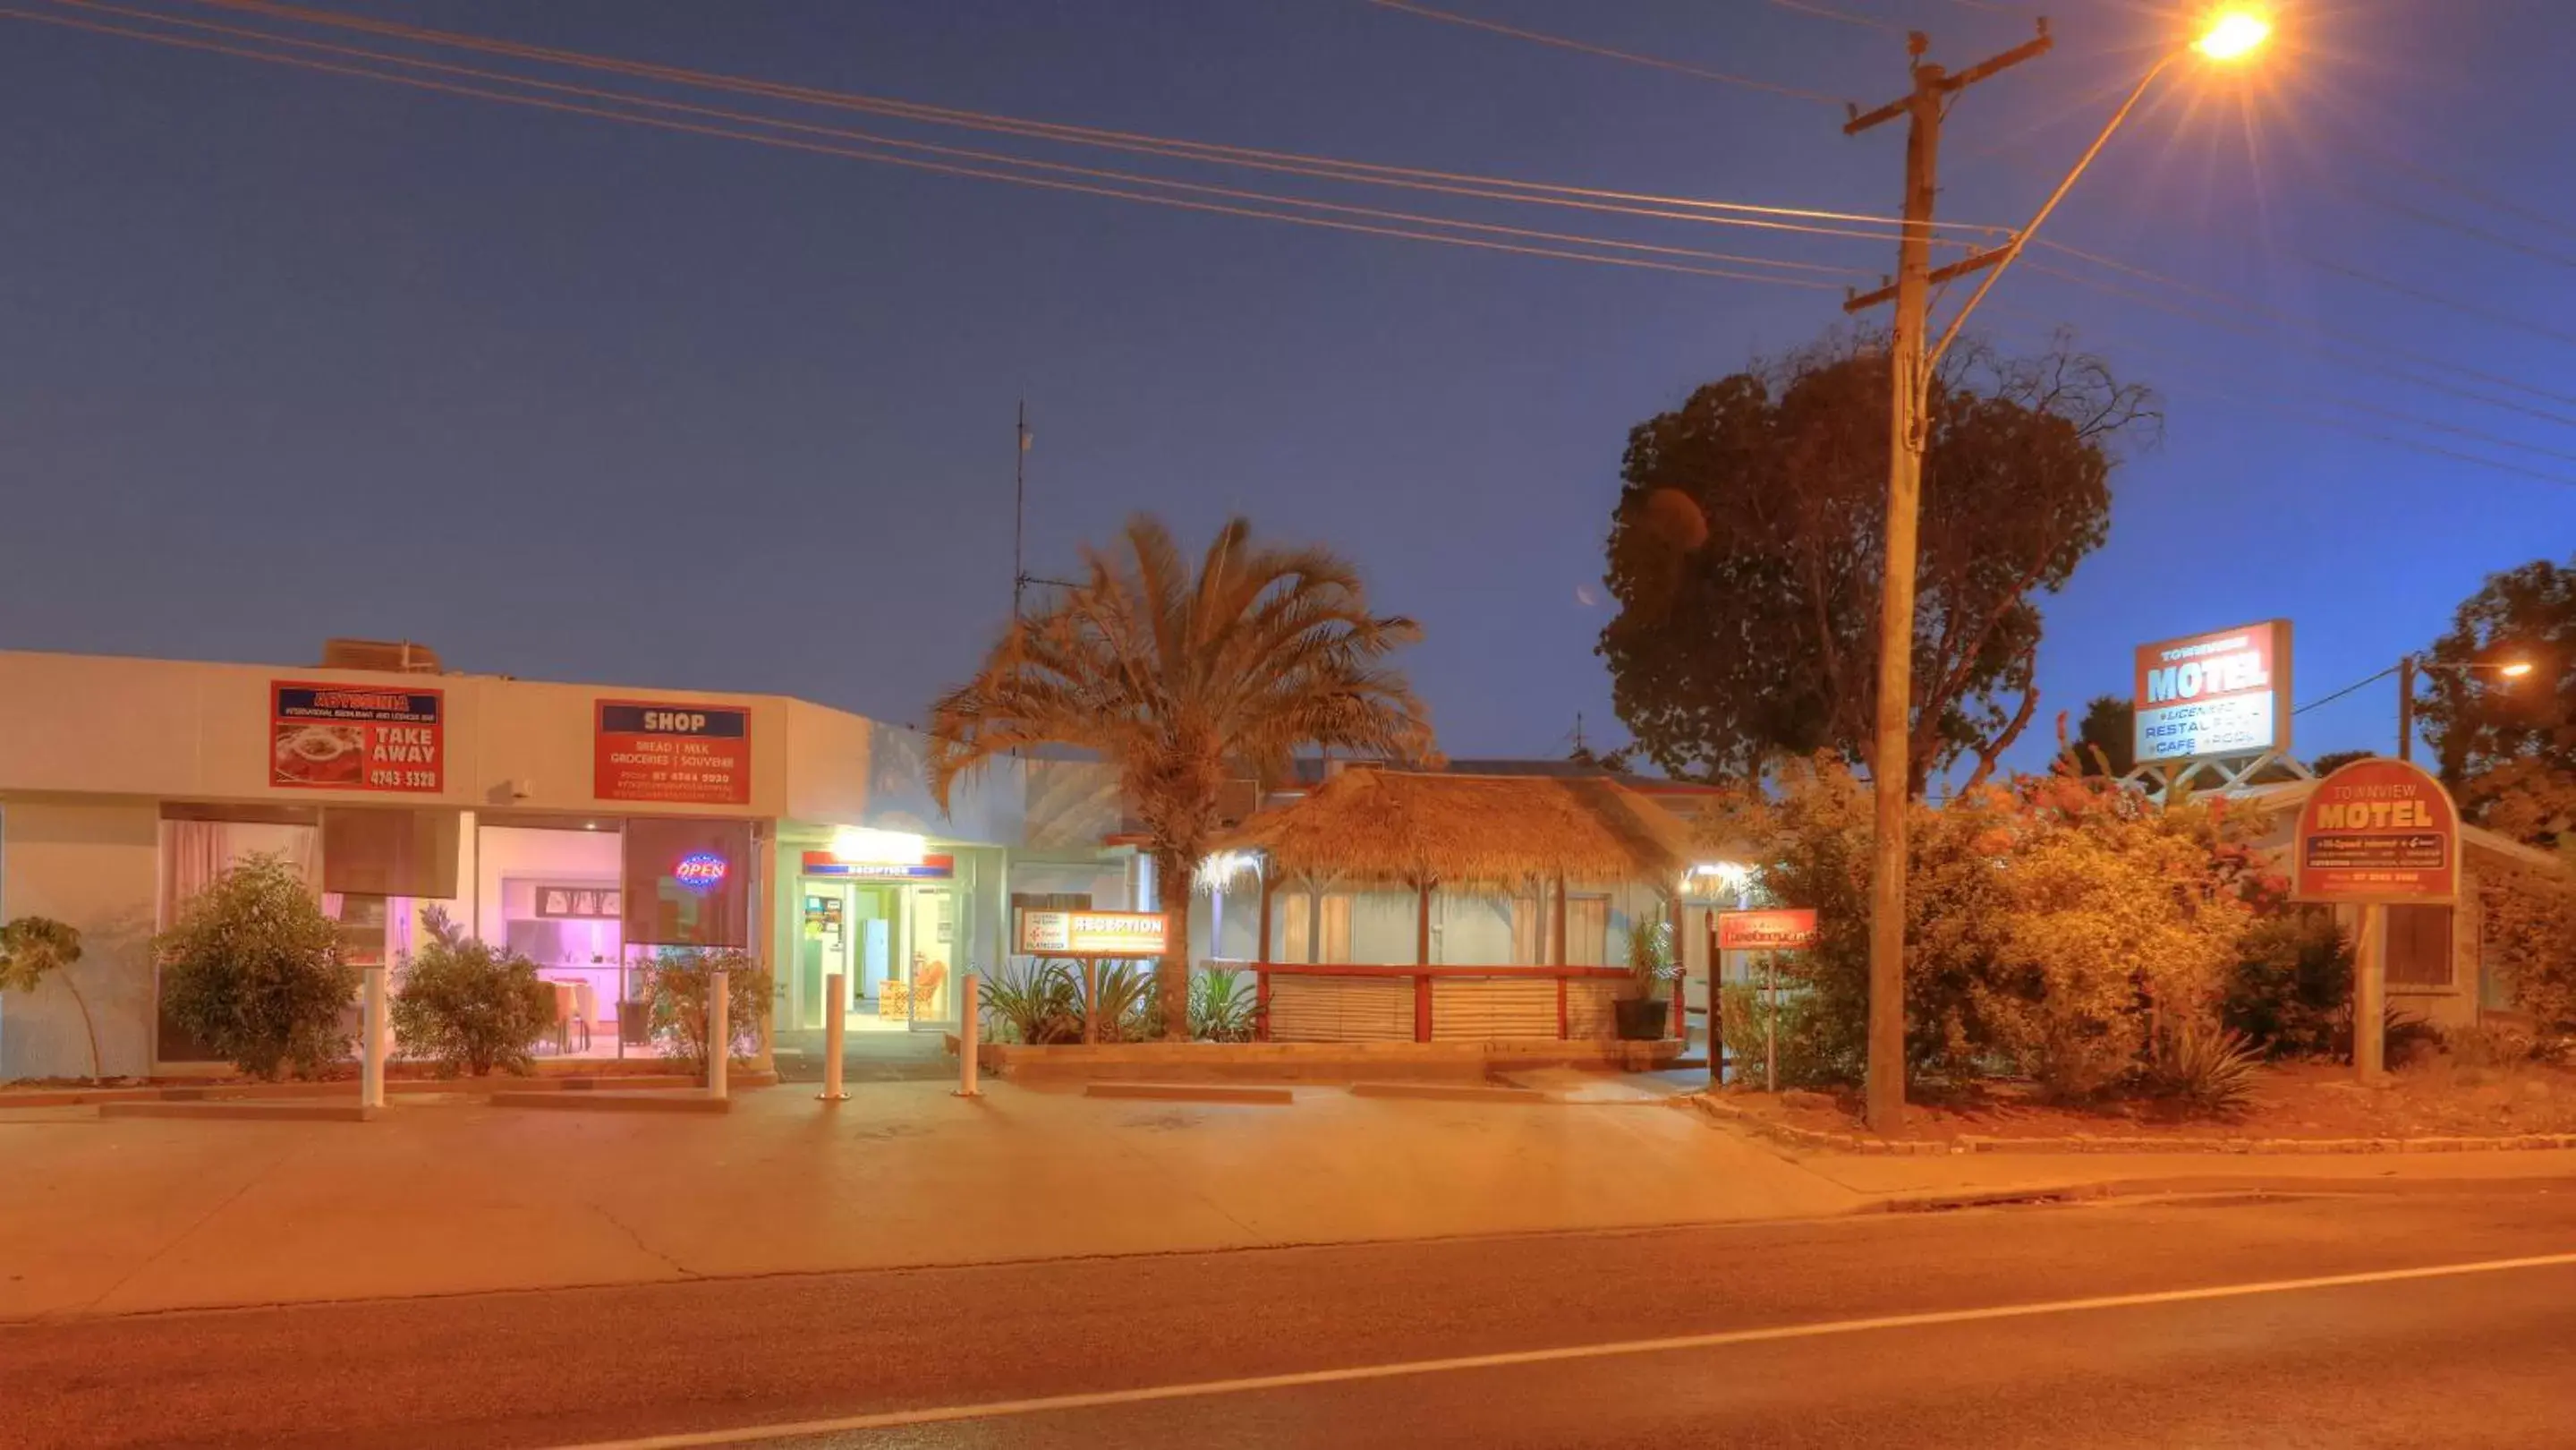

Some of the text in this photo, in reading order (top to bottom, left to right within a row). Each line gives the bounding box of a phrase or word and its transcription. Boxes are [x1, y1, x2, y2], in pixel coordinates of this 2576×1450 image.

[2161, 636, 2249, 661] TOWN
[2148, 651, 2268, 704] MOTEL
[644, 712, 705, 731] SHOP
[2146, 712, 2260, 738] RESTAU
[376, 727, 433, 745] TAKE
[373, 745, 435, 763] AWAY
[684, 743, 710, 755] MILK
[2317, 800, 2433, 829] MOTEL
[676, 861, 725, 878] OPEN
[1075, 918, 1163, 933] RECEPTION
